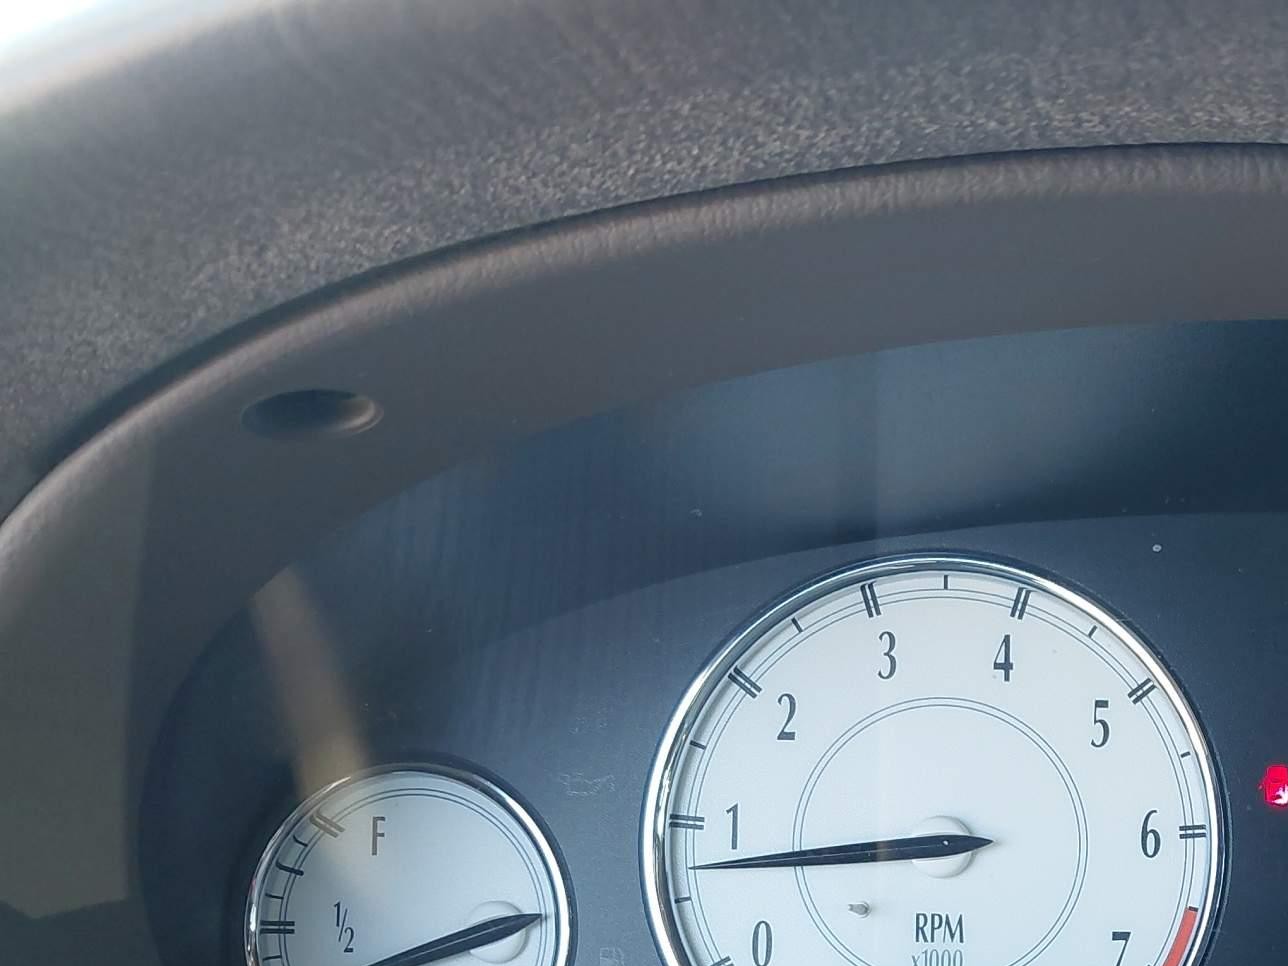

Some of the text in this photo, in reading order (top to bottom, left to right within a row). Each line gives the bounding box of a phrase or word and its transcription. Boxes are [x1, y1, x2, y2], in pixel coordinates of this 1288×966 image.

[877, 632, 897, 679] 3
[993, 634, 1014, 682] 4
[777, 693, 796, 740] 2
[1090, 700, 1109, 747] 5
[372, 816, 385, 856] F
[726, 803, 739, 850] 1
[1140, 810, 1161, 858] 6
[915, 914, 965, 943] RPM
